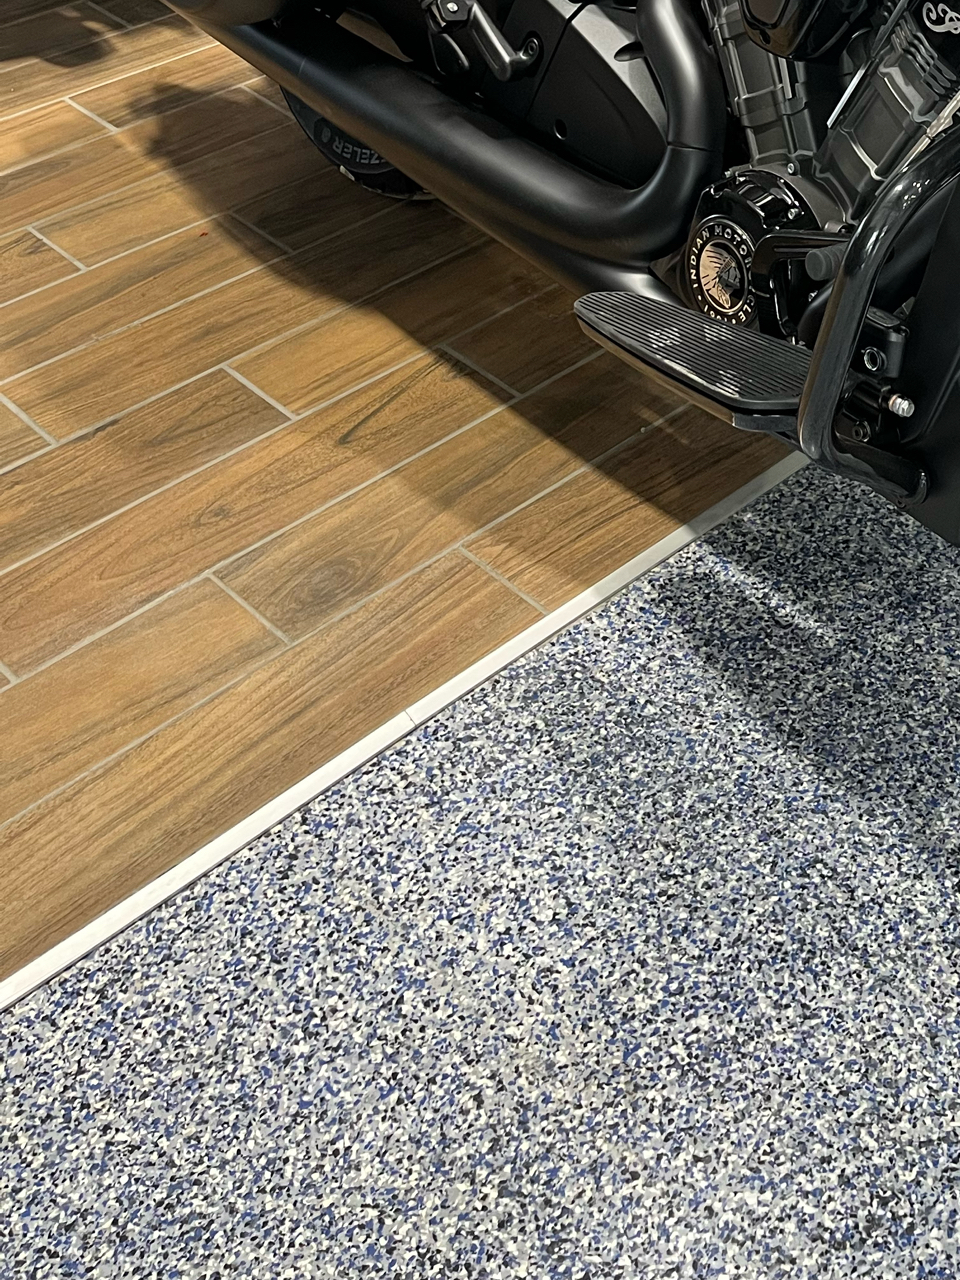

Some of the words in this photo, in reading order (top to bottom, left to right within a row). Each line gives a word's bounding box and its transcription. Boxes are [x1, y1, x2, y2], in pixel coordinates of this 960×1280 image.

[332, 136, 386, 165] ZELER
[690, 229, 710, 288] INDIAN
[714, 224, 755, 323] MOTORCLE
